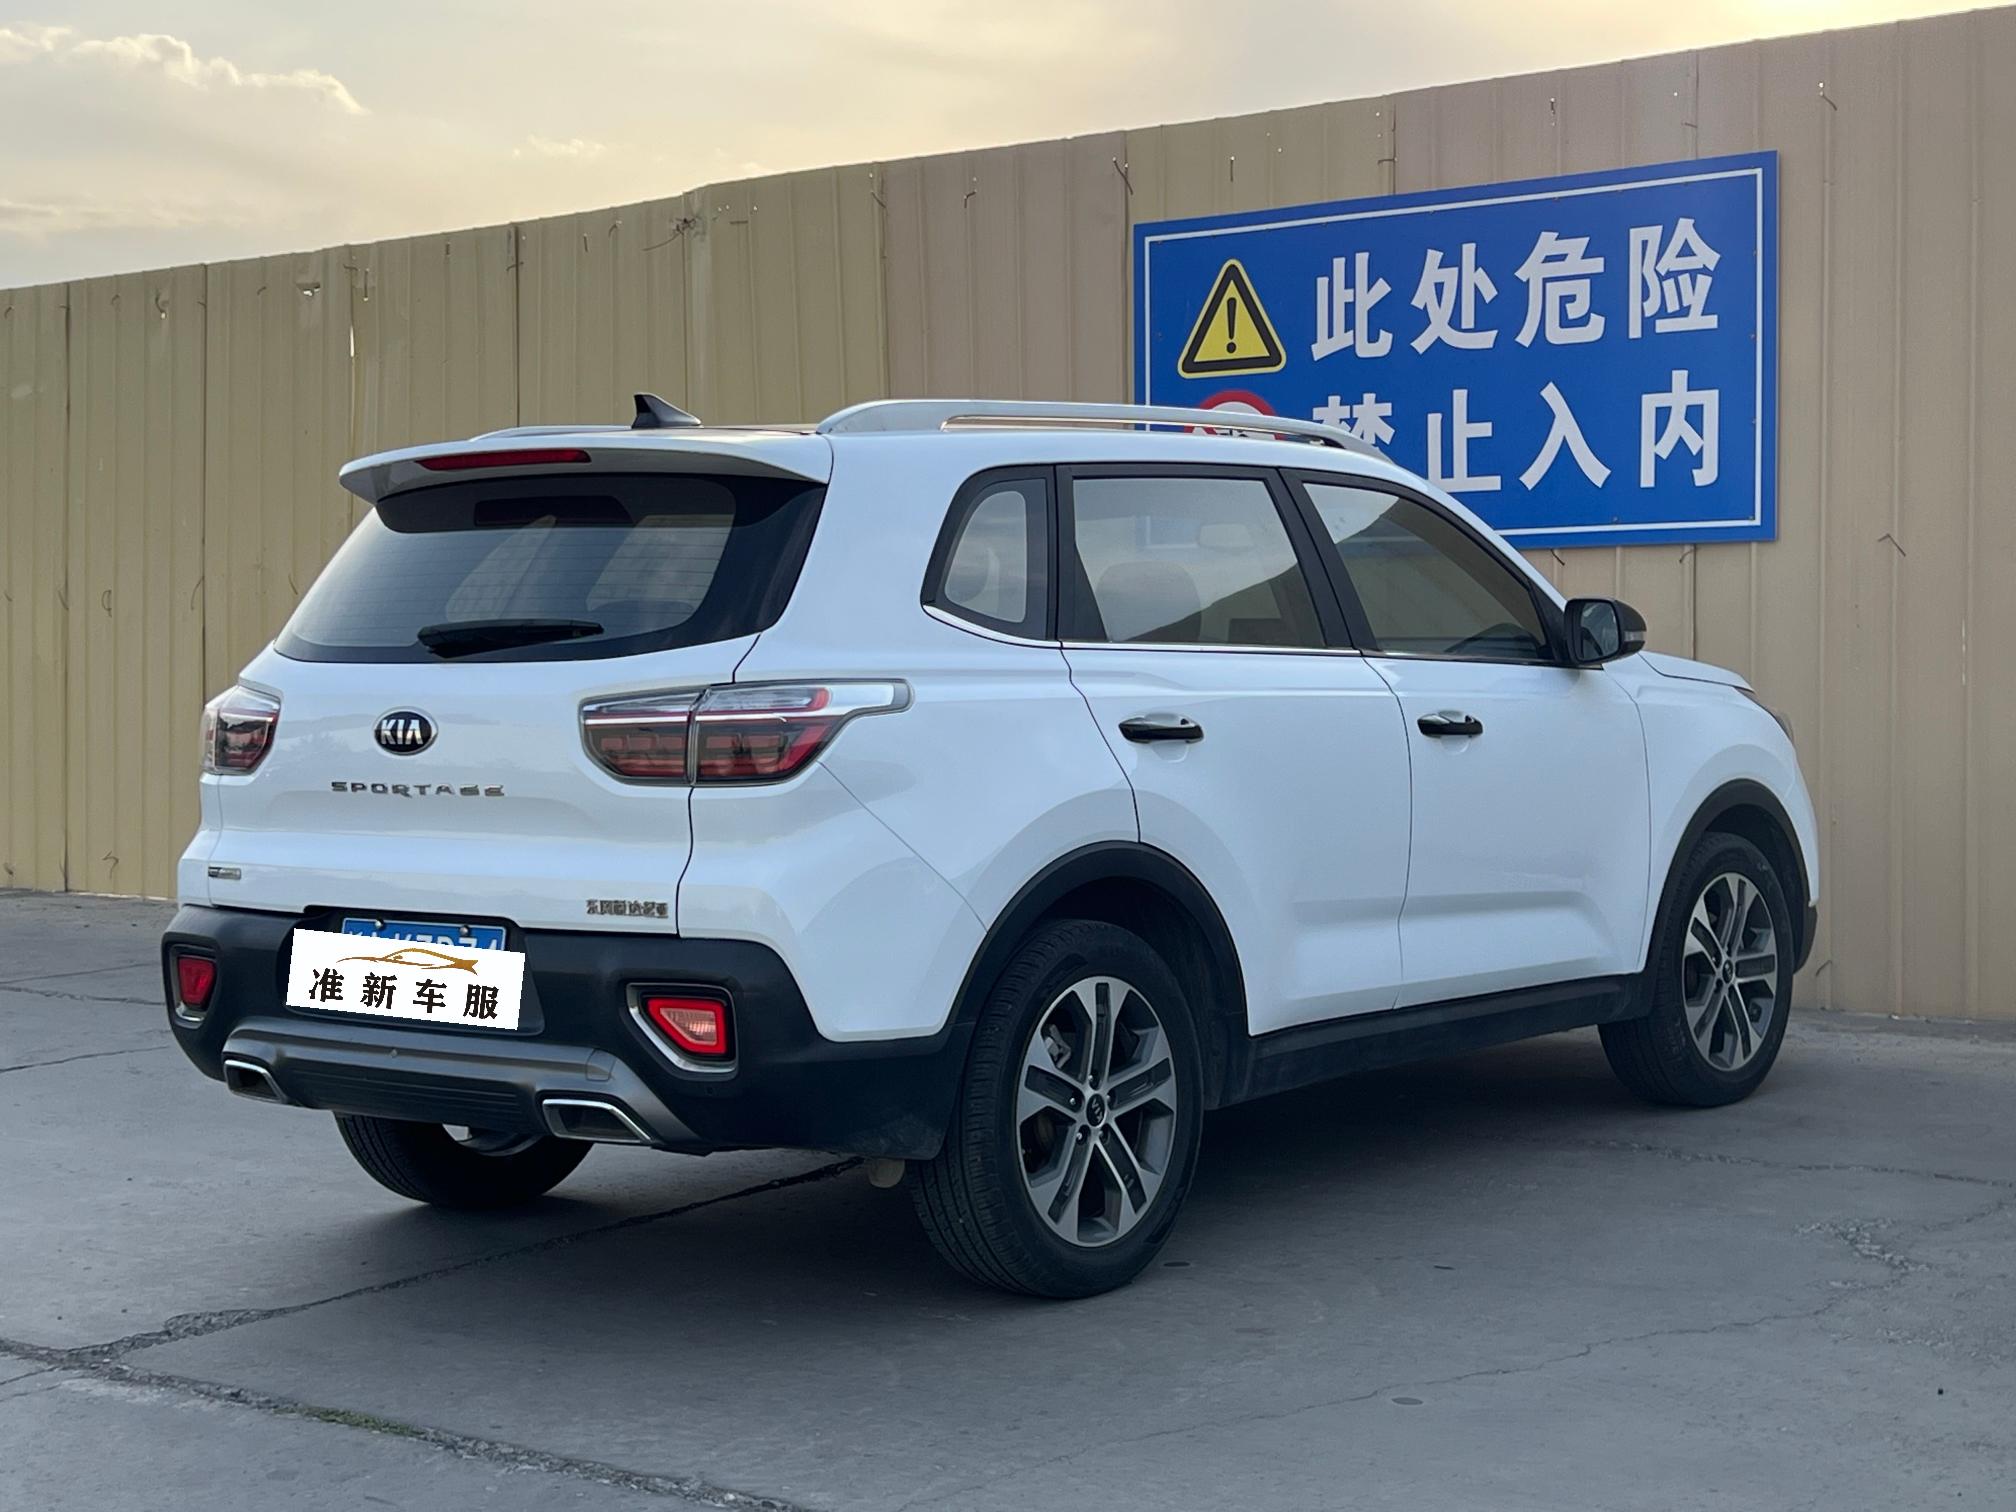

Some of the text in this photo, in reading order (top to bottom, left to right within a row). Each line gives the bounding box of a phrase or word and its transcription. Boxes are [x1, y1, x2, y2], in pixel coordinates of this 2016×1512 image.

[1311, 217, 1720, 362] 此处危险
[380, 718, 424, 745] KIA
[331, 781, 505, 798] SPORTAGE
